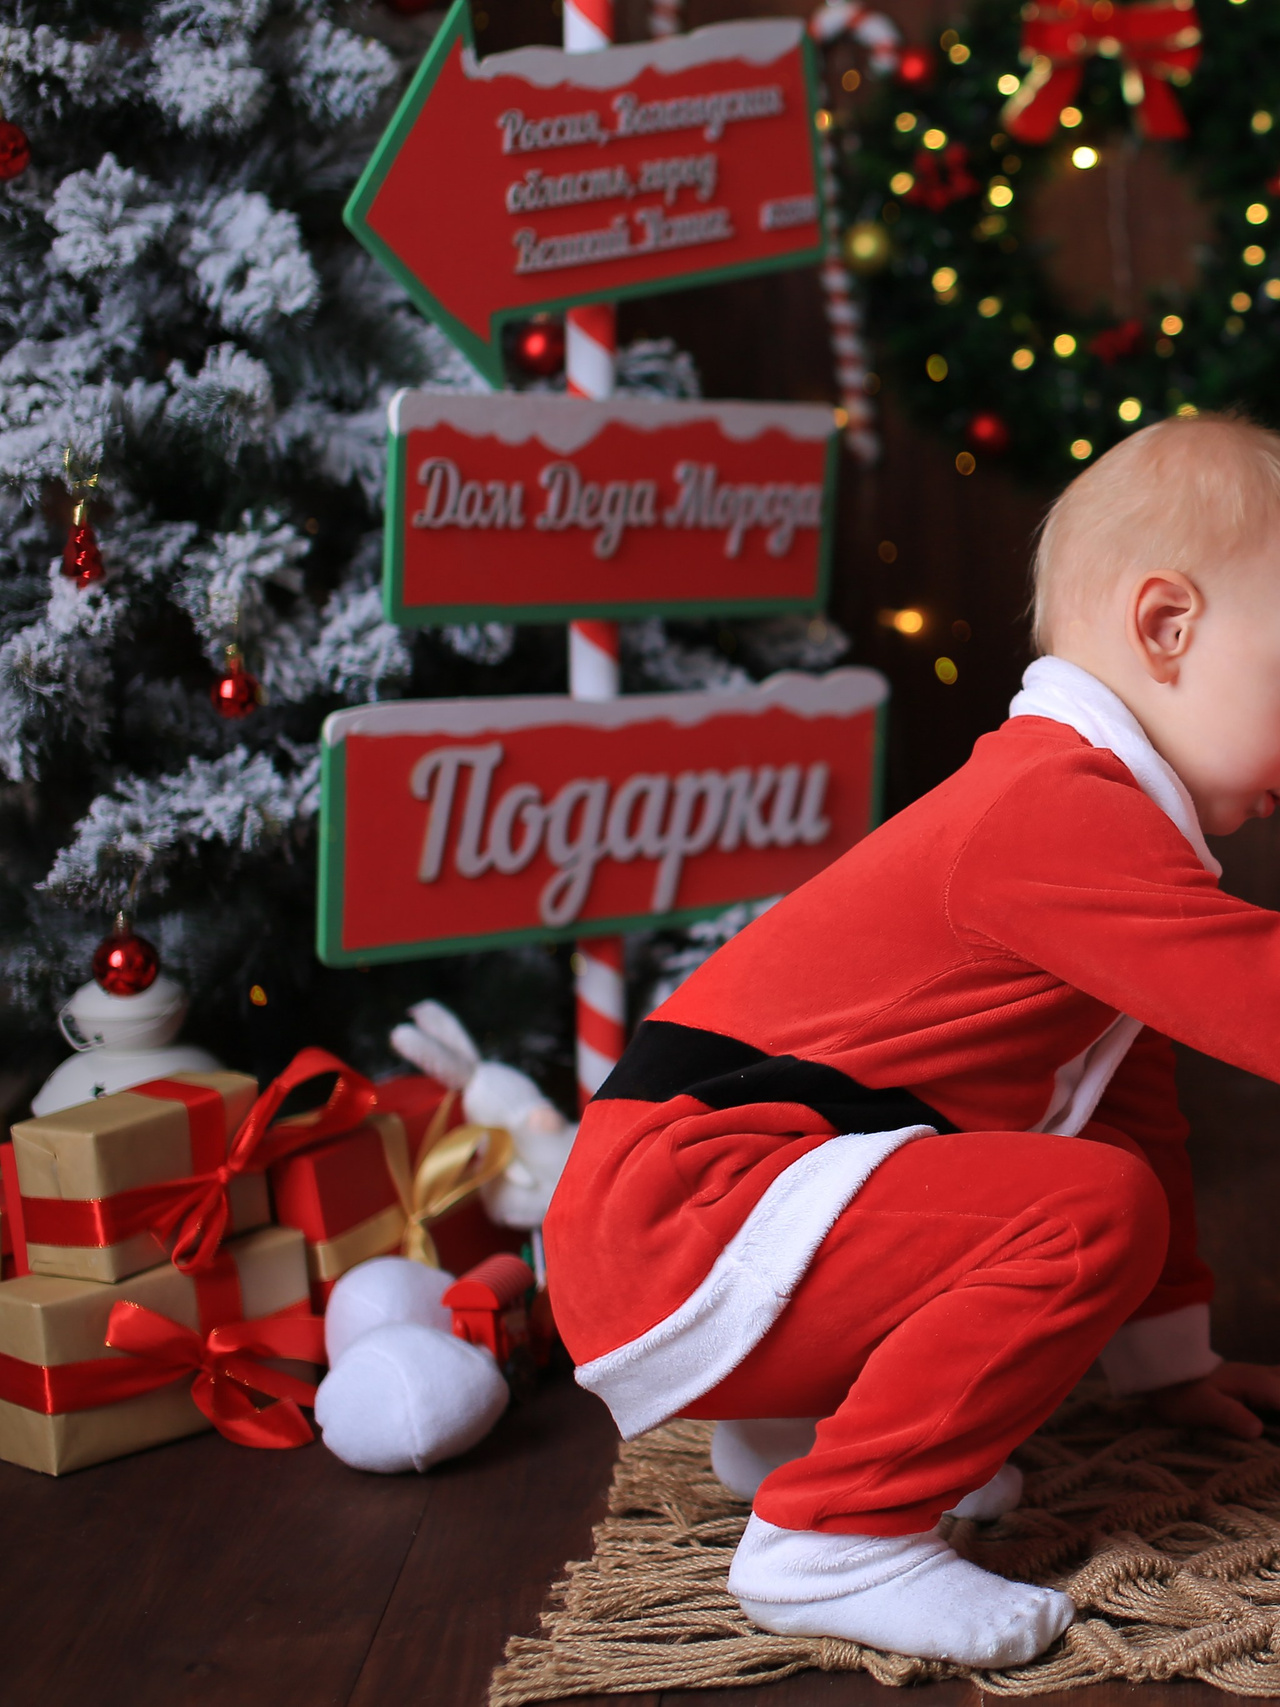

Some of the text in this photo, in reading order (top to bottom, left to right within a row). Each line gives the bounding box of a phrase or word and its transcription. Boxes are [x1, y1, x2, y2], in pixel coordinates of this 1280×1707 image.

[412, 457, 823, 559] Дом Деда Мороза
[411, 740, 830, 927] Подарки
